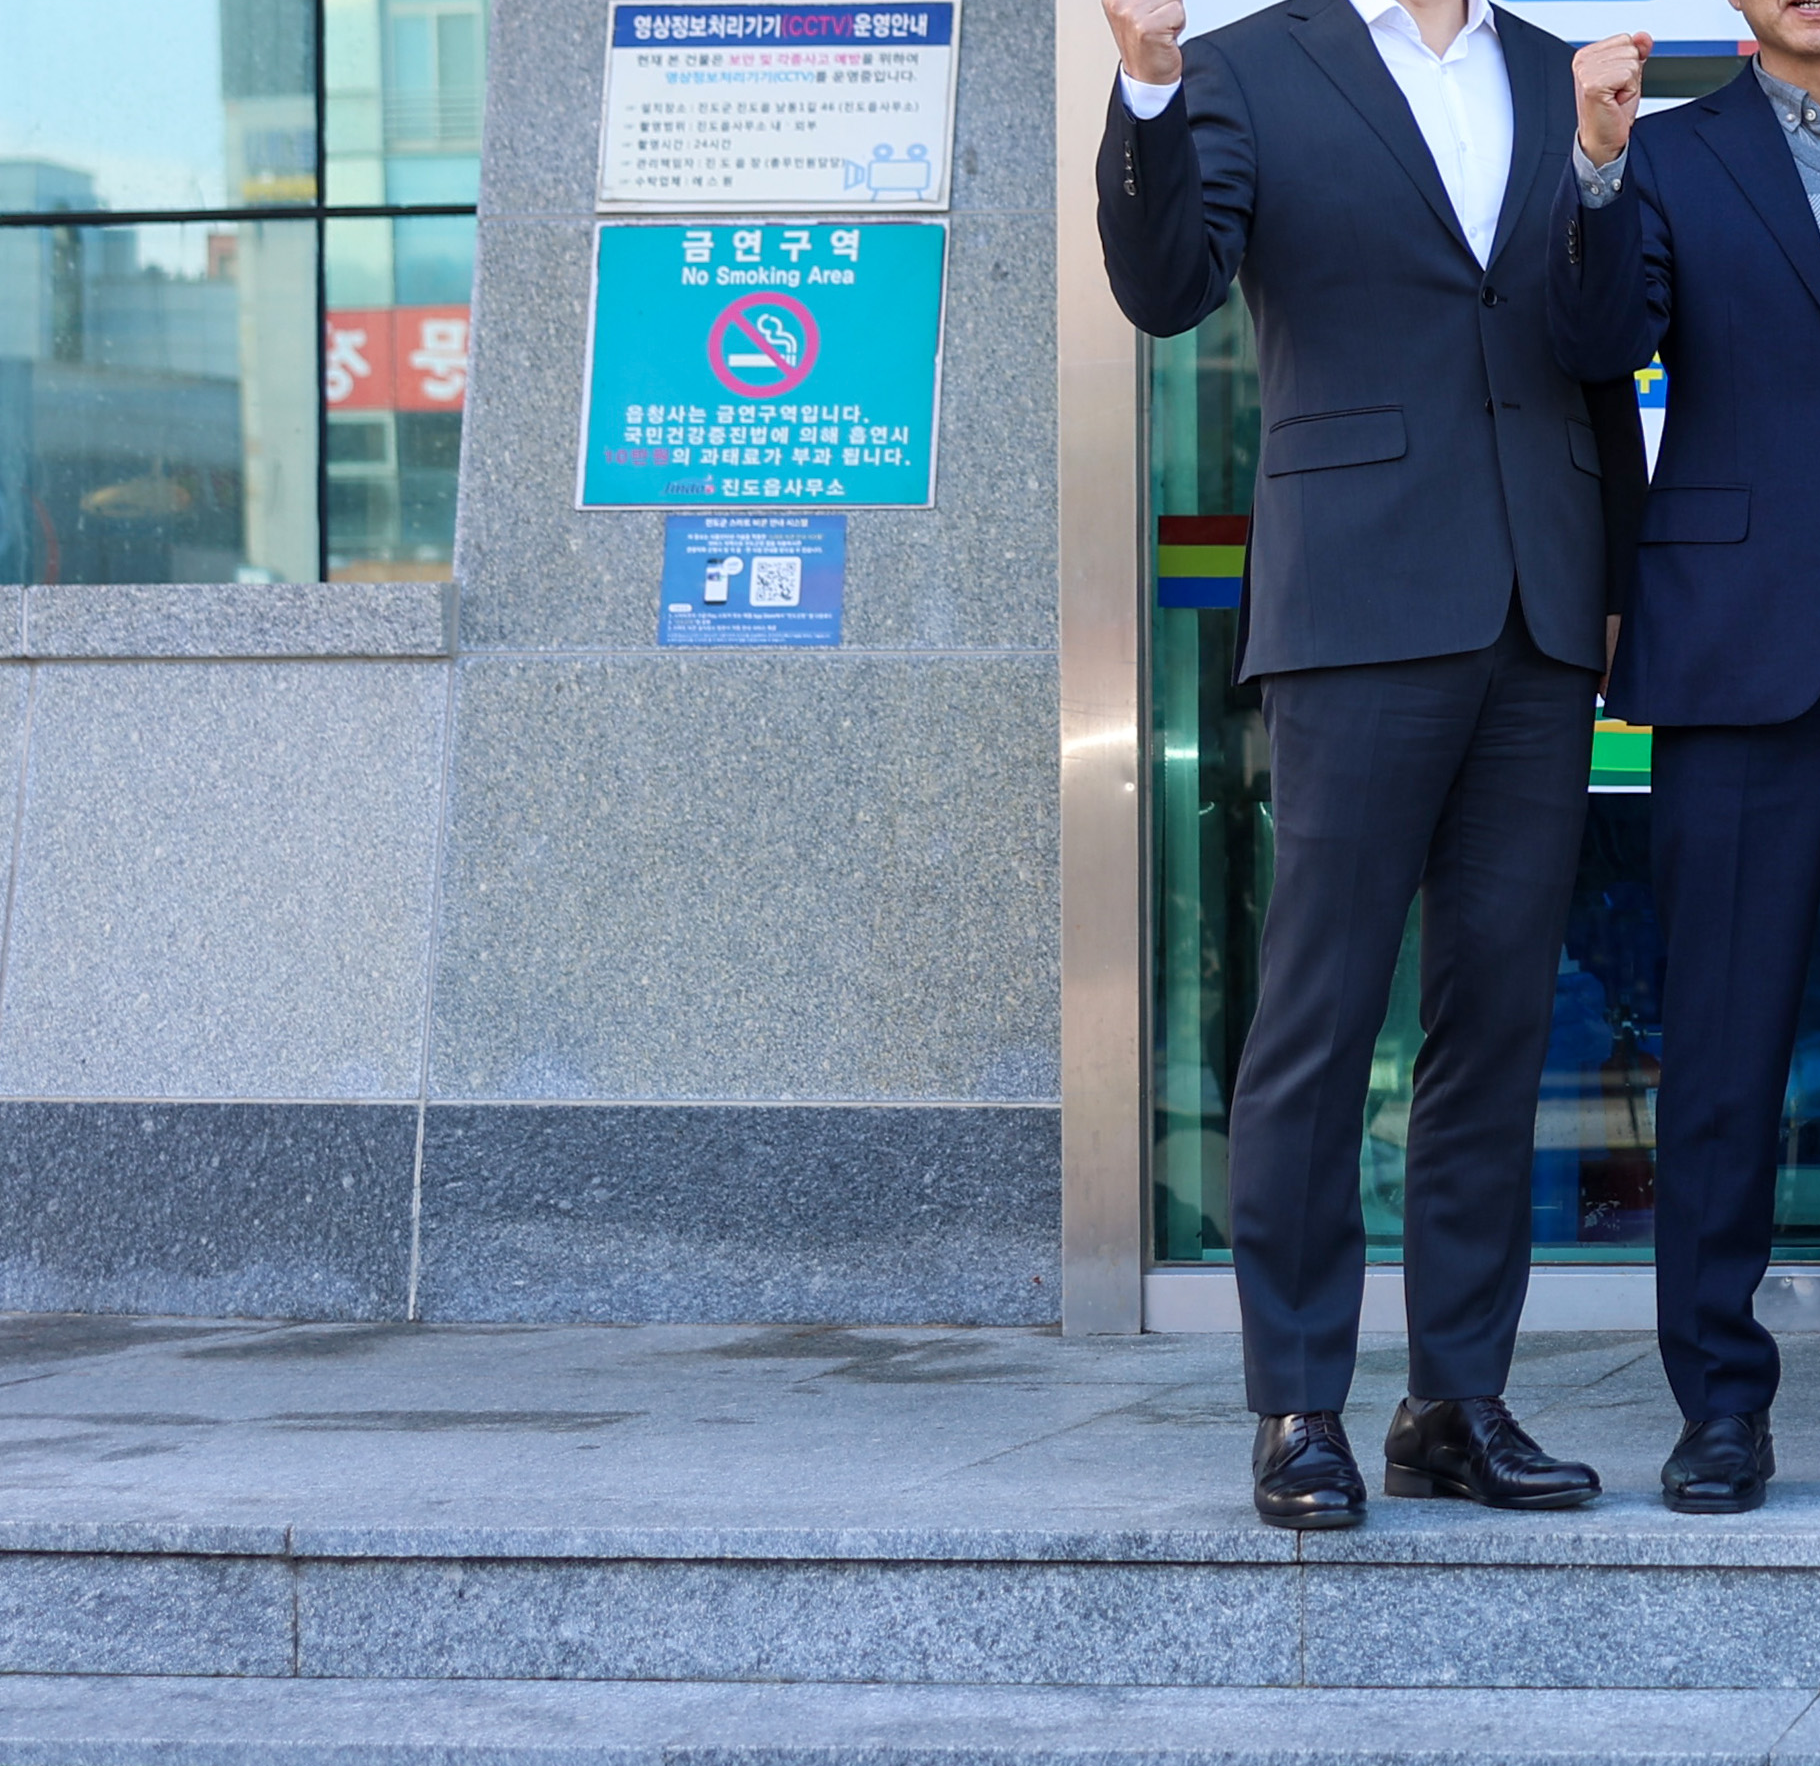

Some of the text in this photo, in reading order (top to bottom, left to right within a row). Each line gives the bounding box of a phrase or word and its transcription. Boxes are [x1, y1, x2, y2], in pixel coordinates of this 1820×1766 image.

[681, 265, 855, 288] No Smoking Area
[625, 404, 870, 424] 읍청사는 금연구역입니다.
[624, 425, 909, 446] 국민건강증진법에 의해 흡연시
[701, 447, 782, 466] 과태료가
[791, 447, 832, 466] 부과
[841, 447, 911, 467] 됩니다.
[721, 478, 846, 498] 진도읍사무소
